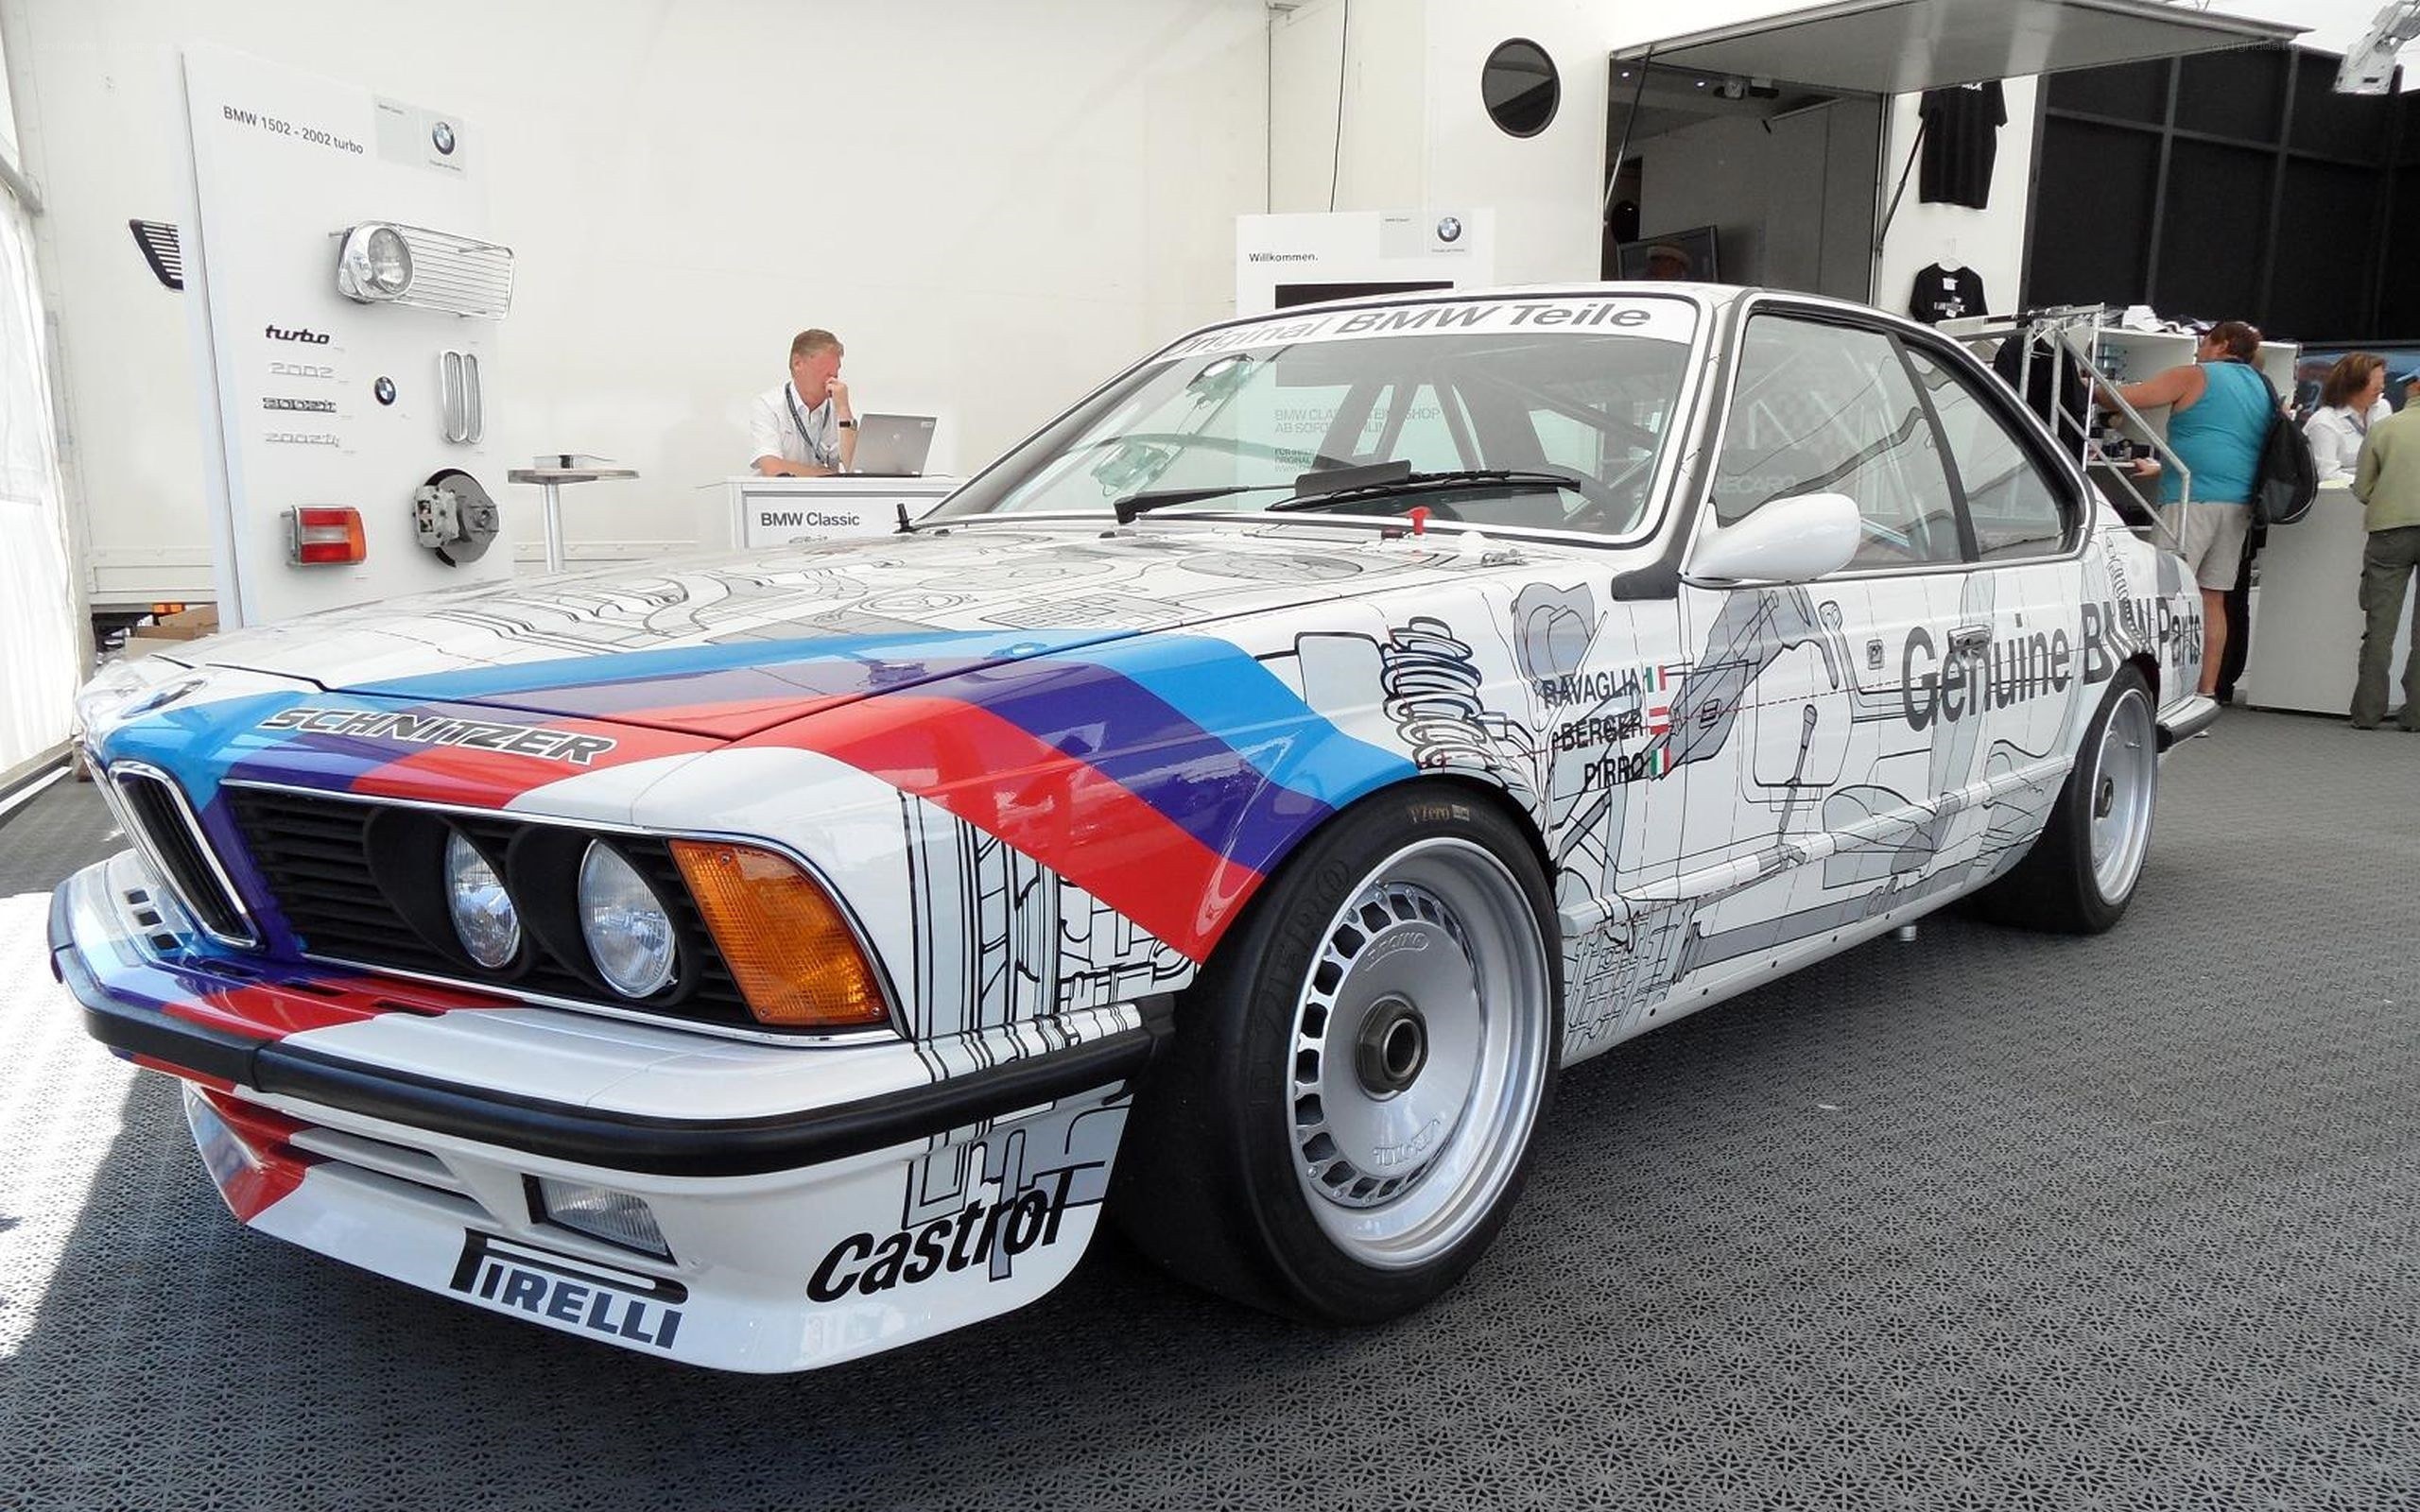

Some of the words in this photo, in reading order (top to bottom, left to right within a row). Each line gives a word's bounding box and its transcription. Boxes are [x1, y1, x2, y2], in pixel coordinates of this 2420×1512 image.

[223, 106, 257, 127] BMW
[261, 116, 291, 135] 1502
[302, 128, 331, 146] 2002
[334, 137, 364, 155] turbo
[1249, 251, 1319, 264] Willkommen.
[266, 324, 330, 345] turbo
[1334, 305, 1502, 334] BMW
[1510, 303, 1651, 327] Teile
[270, 362, 335, 378] 2002
[761, 512, 804, 527] BMW
[806, 511, 861, 527] Classic
[1902, 612, 2070, 732] Genuine
[2155, 597, 2202, 669] Parts
[1542, 667, 1641, 709] RAVAGLIA
[256, 708, 617, 766] SCHNITZER
[1560, 708, 1644, 752] BERGER
[1583, 752, 1645, 794] PIRRO
[806, 1168, 1074, 1303] Castrol
[449, 1228, 689, 1349] PIRELLI
